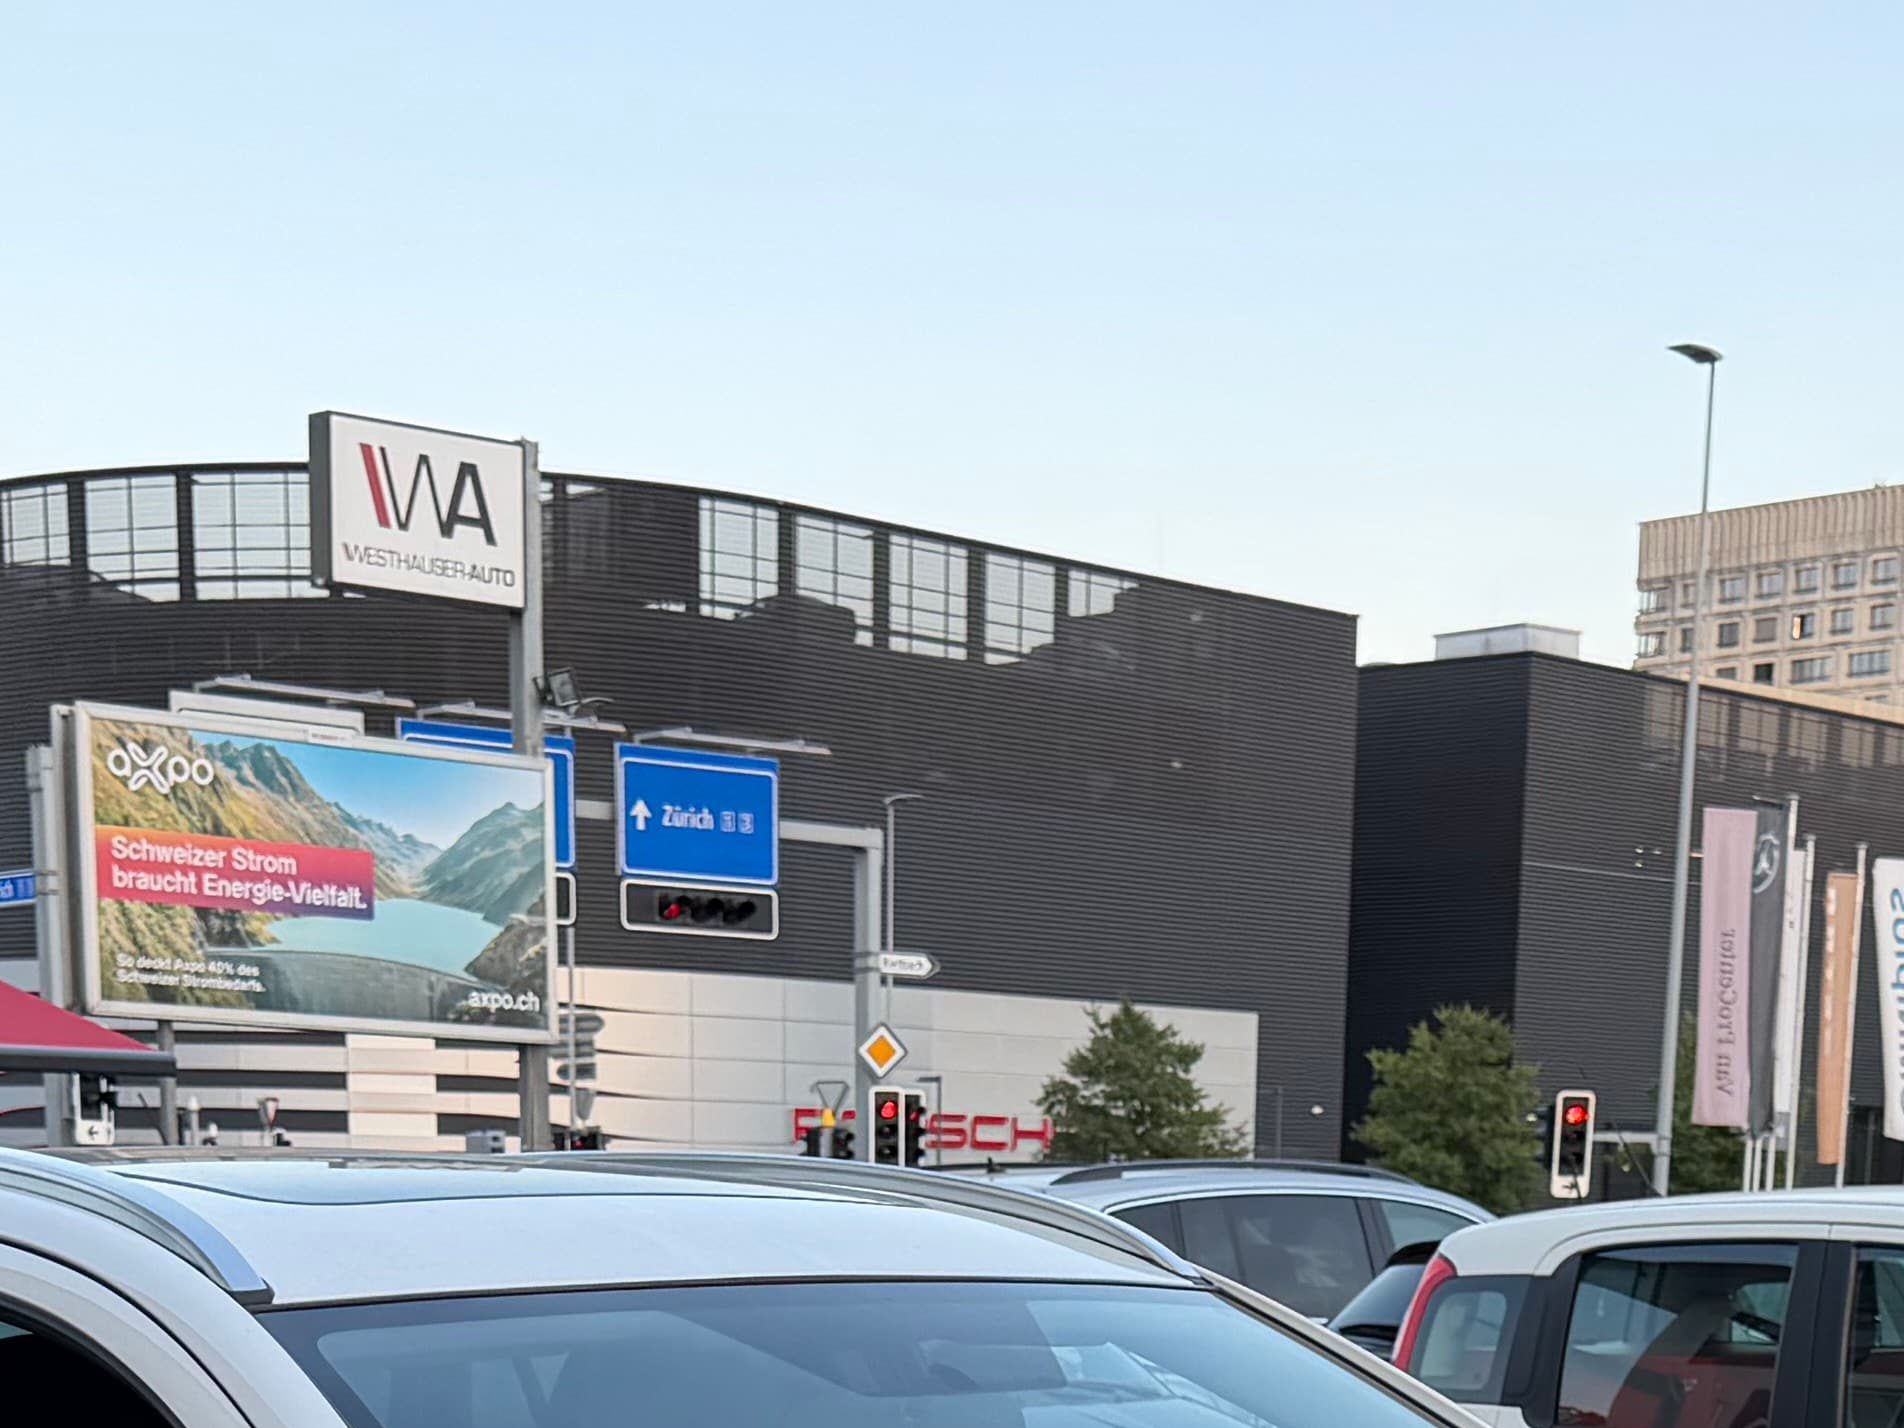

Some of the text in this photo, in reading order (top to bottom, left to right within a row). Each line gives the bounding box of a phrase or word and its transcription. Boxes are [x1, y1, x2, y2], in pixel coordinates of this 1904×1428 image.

[342, 541, 515, 588] WESTHAUSER-AUTO
[107, 742, 215, 794] axpo
[662, 804, 714, 831] Zürich
[111, 835, 296, 876] Schweizer Strom
[112, 864, 368, 910] braucht Energie-Vielfalt.
[468, 990, 540, 1013] axpo.ch
